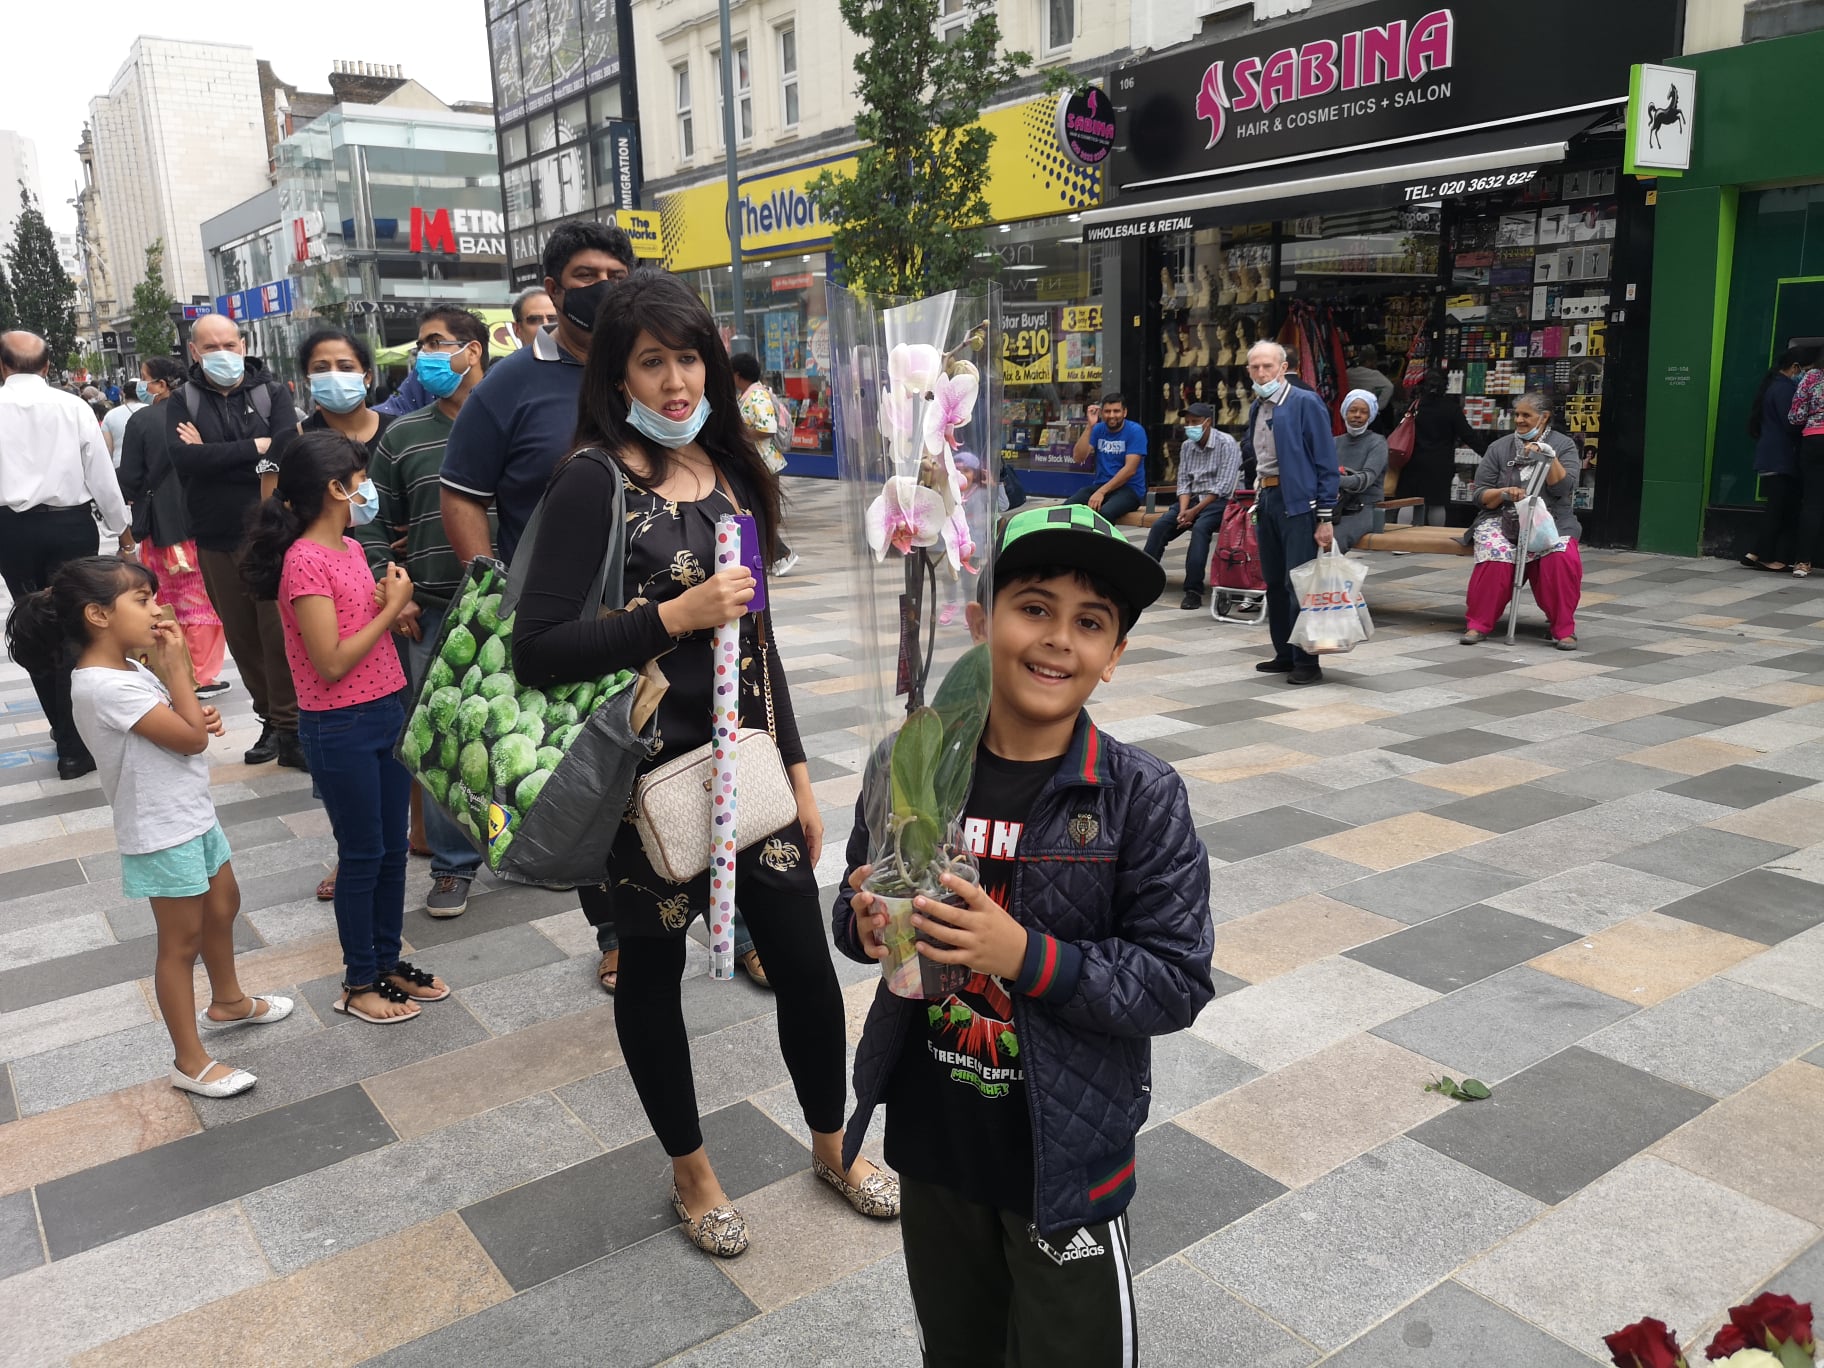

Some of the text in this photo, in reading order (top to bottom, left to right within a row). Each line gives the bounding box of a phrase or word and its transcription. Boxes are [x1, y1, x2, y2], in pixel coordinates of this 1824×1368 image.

[1232, 9, 1453, 113] SABINA
[1120, 77, 1135, 90] 106
[1236, 82, 1451, 138] HAIR & COSMETICS + SALON
[1067, 113, 1114, 139] SABINA
[618, 137, 633, 211] MMIGRATION
[1404, 170, 1538, 201] TEL: 020 3632 825
[630, 216, 650, 229] The
[738, 187, 834, 237] TheWor
[624, 229, 657, 240] Works
[1088, 216, 1194, 241] WHOLESALE & RETAIL
[459, 237, 506, 255] BAN
[1021, 310, 1048, 330] Buys!
[1068, 309, 1077, 329] 3
[1003, 332, 1010, 357] 2
[1016, 328, 1049, 356] £10
[1015, 369, 1022, 381] &
[1024, 368, 1050, 381] Match!
[1067, 370, 1079, 380] Mix
[1087, 369, 1103, 380] Mat
[1034, 454, 1047, 463] New
[1048, 453, 1063, 463] Stock
[1302, 591, 1351, 607] TESCO
[961, 817, 1024, 861] RN
[927, 1040, 983, 1075] ETREMELY
[951, 1068, 1010, 1098] MINERAFT
[1061, 1245, 1105, 1261] adidas
